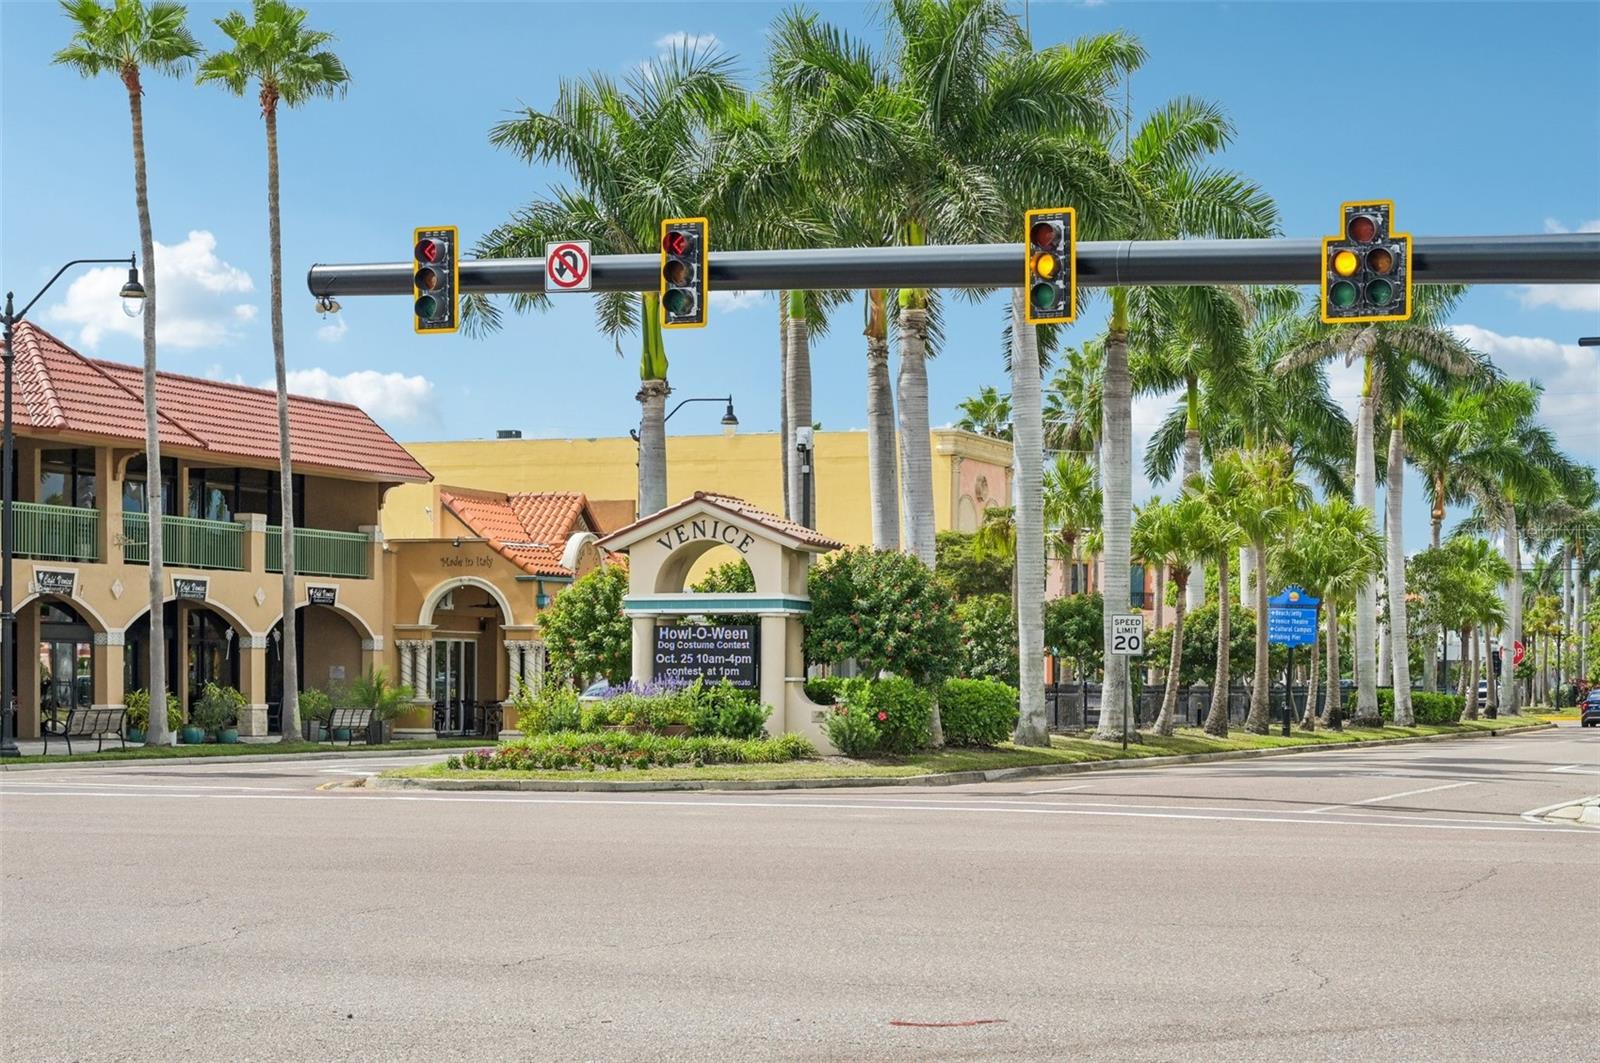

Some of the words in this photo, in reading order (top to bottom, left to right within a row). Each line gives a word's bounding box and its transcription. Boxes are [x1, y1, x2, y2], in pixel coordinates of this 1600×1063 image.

[657, 520, 755, 554] VENICE
[465, 557, 473, 567] in
[476, 556, 493, 569] Italy
[659, 627, 748, 640] Howl-O-Ween
[657, 641, 675, 651] Dog
[676, 641, 715, 649] Costume
[716, 641, 750, 649] Contest
[1114, 635, 1140, 650] 20
[655, 653, 678, 664] Oct.
[680, 653, 694, 664] 25
[696, 653, 752, 666] 10am-4pm
[666, 667, 702, 676] contest
[706, 667, 717, 676] at
[719, 666, 740, 677] 1pm
